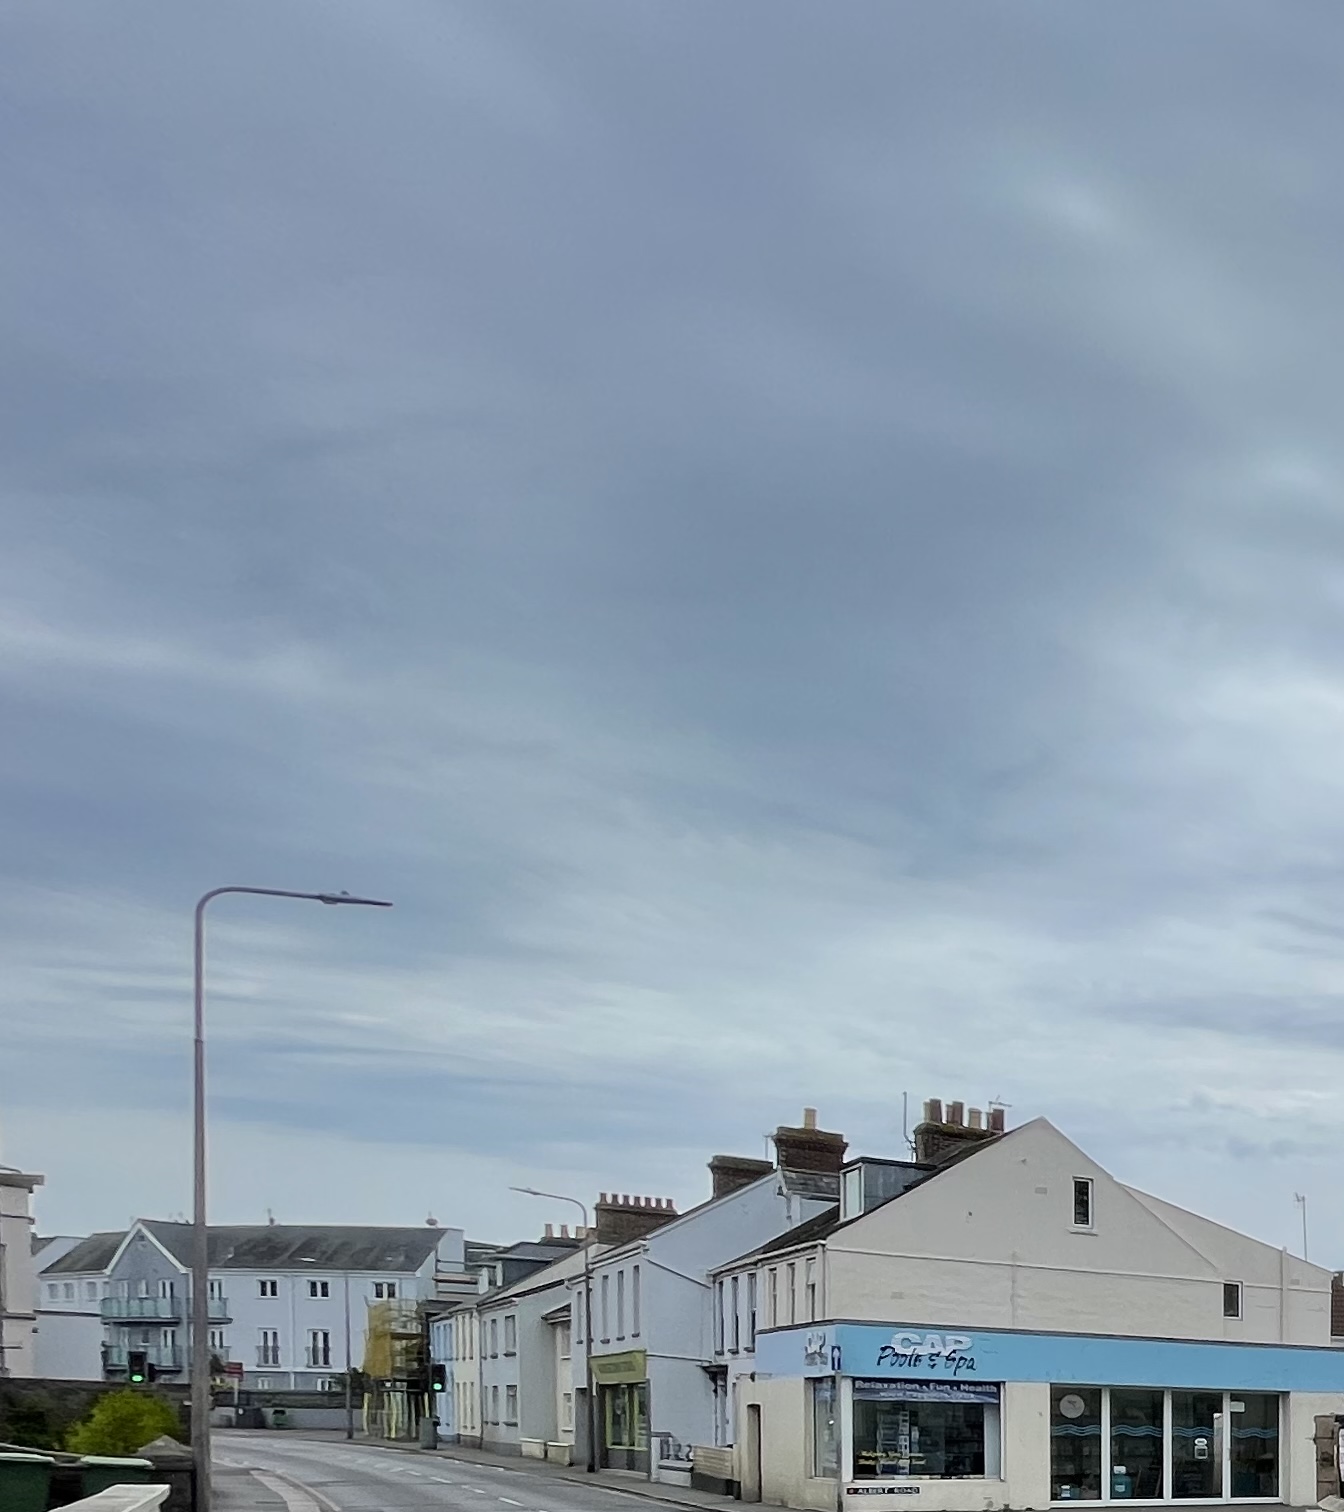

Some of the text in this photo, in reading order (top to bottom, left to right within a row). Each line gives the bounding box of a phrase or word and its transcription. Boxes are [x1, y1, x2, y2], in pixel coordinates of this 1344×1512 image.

[890, 1332, 973, 1356] CAP
[944, 1349, 977, 1377] Spa
[855, 1380, 997, 1392] Relaxation Fun Health
